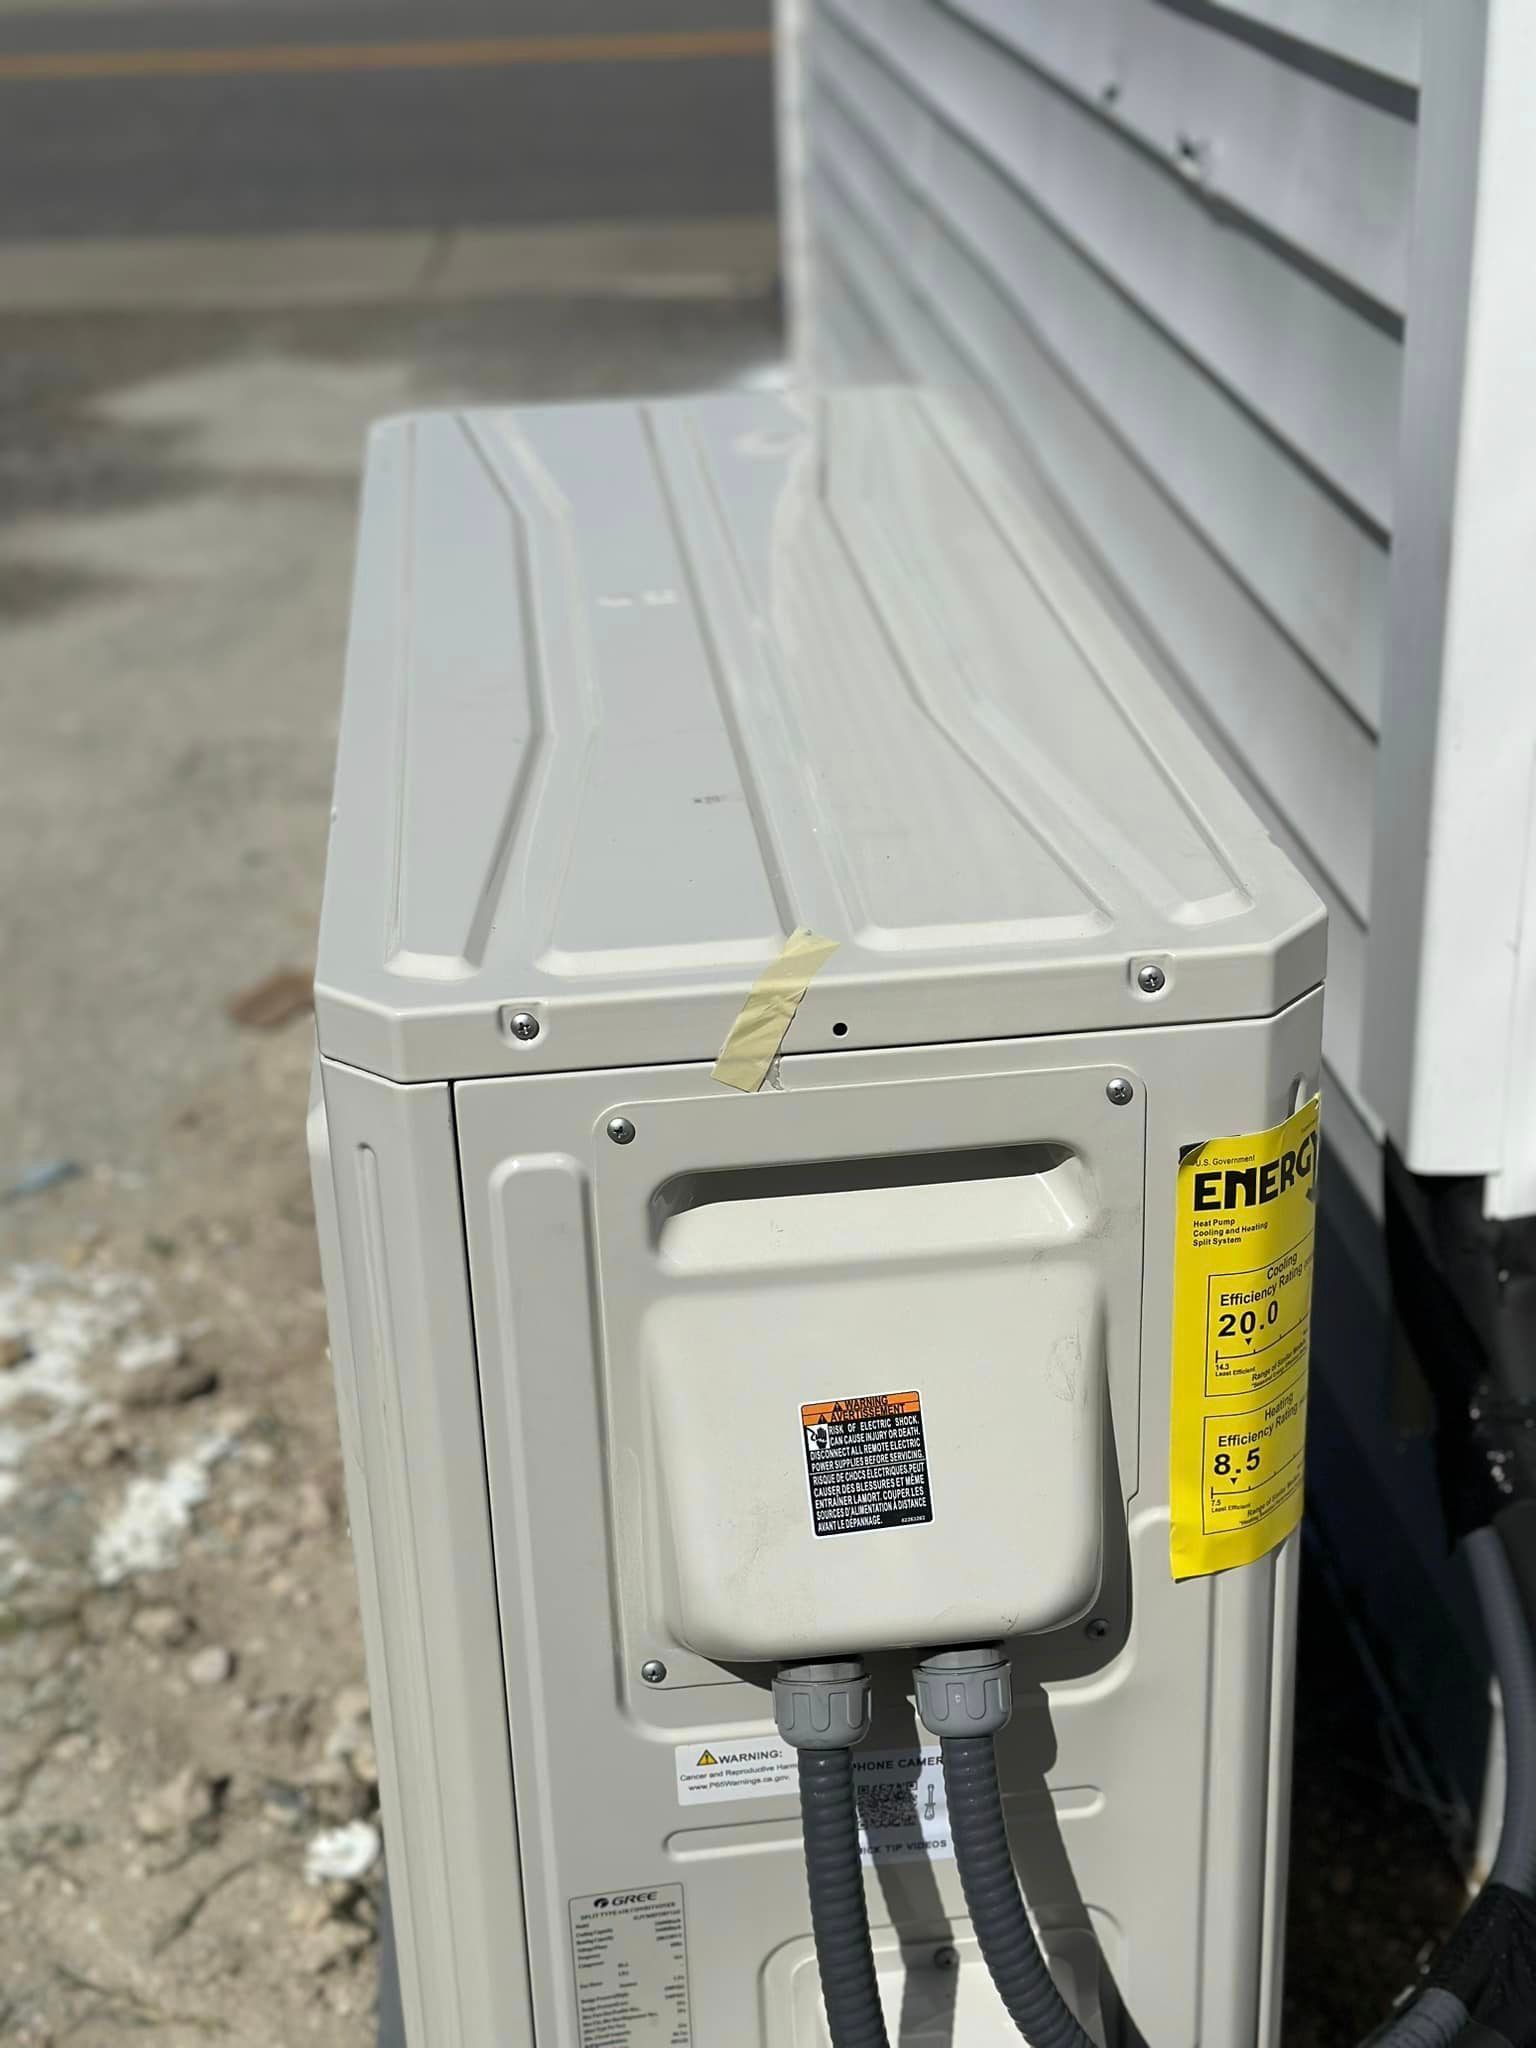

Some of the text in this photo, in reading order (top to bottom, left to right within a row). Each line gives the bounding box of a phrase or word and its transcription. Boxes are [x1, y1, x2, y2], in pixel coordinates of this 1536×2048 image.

[1196, 1155, 1255, 1167] U.S. Government
[1193, 1218, 1235, 1228] Heat Pump
[1193, 1227, 1224, 1237] Cooling
[1242, 1221, 1268, 1233] Heating
[1193, 1236, 1242, 1247] Split System
[1267, 1252, 1298, 1280] Cooling
[1220, 1263, 1303, 1306] Efficiency Rating
[1218, 1300, 1278, 1337] 20.0
[845, 1395, 888, 1410] WARNING
[1264, 1391, 1294, 1421] Heating
[831, 1403, 905, 1422] AVERTISSEMENT
[828, 1415, 920, 1434] RISK OF ELECTRIC SHOCK.
[1218, 1403, 1298, 1448] Efficiency Rating
[830, 1427, 921, 1446] CAN CAUSE INJURY OR DEATH.
[810, 1438, 921, 1460] DISCONNECT ALL REMOTE ELECTRIC
[812, 1449, 924, 1471] POWER SUPPLIES BEFORE SERVICING.
[1213, 1447, 1261, 1476] 8.5
[813, 1474, 835, 1486] RISQUE
[836, 1472, 844, 1482] DE
[845, 1470, 866, 1480] CHOCS
[909, 1462, 925, 1472] PEUT
[814, 1486, 840, 1497] CAUSER
[842, 1483, 855, 1493] DES
[856, 1478, 895, 1492] BLESSURES
[896, 1477, 904, 1486] ET
[883, 1488, 910, 1500] COUPER
[911, 1486, 924, 1496] LES
[816, 1508, 844, 1520] SOURCES
[898, 1497, 927, 1509] DISTANCE
[818, 1521, 836, 1532] AVANT
[837, 1520, 845, 1529] LE
[719, 1750, 782, 1764] WARNING:
[853, 1760, 893, 1771] HONE
[680, 1773, 707, 1781] Cancer
[709, 1770, 723, 1778] and
[725, 1766, 775, 1776] Reproductive
[885, 1844, 903, 1853] TIP
[907, 1840, 946, 1850] VIDEOS
[612, 1891, 658, 1906] GREE
